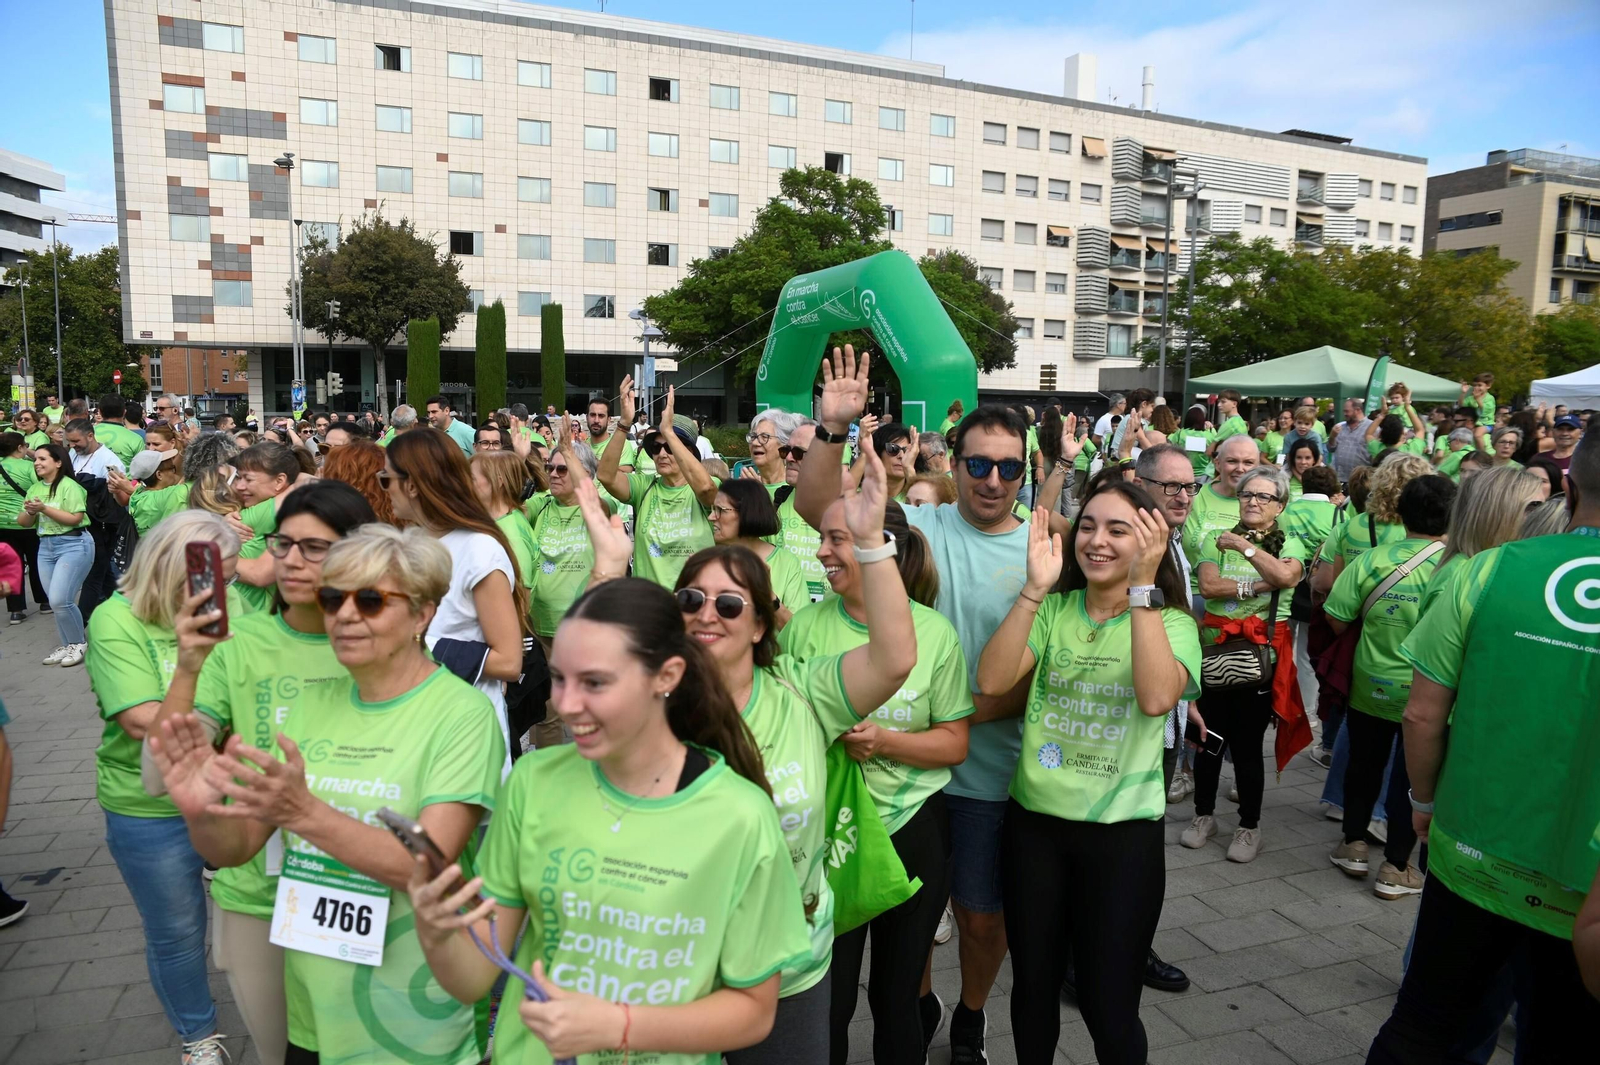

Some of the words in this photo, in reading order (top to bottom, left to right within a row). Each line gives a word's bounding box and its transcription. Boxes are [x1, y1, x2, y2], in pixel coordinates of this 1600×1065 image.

[786, 287, 795, 298] En
[795, 282, 819, 296] marcha
[786, 300, 806, 313] contra
[682, 515, 692, 525] el
[785, 531, 798, 541] En
[1224, 563, 1237, 571] En
[1382, 592, 1419, 603] ECACOR
[1514, 631, 1551, 644] ASOCIACIÓN
[1551, 639, 1584, 651] ESPAÑOLA
[1049, 671, 1068, 689] En
[1073, 682, 1135, 698] marcha
[255, 678, 272, 749] RDOBA
[893, 705, 912, 722] el
[1047, 693, 1108, 717] contra
[1111, 702, 1131, 719] el
[1043, 712, 1128, 741] cáncer
[1066, 758, 1120, 775] CANDELARIA
[1076, 752, 1100, 761] ERMITA
[1075, 769, 1112, 779] RESTAURANTE
[305, 774, 316, 788] n
[318, 774, 401, 800] marcha
[784, 778, 810, 804] el
[601, 867, 627, 878] contra
[637, 875, 668, 886] cáncer
[603, 856, 647, 870] asociación
[648, 866, 689, 880] española
[312, 896, 373, 937] 4766
[562, 891, 592, 921] En
[600, 903, 707, 937] marcha
[559, 931, 659, 971] contra
[663, 940, 695, 968] el
[552, 959, 690, 1006] cáncer
